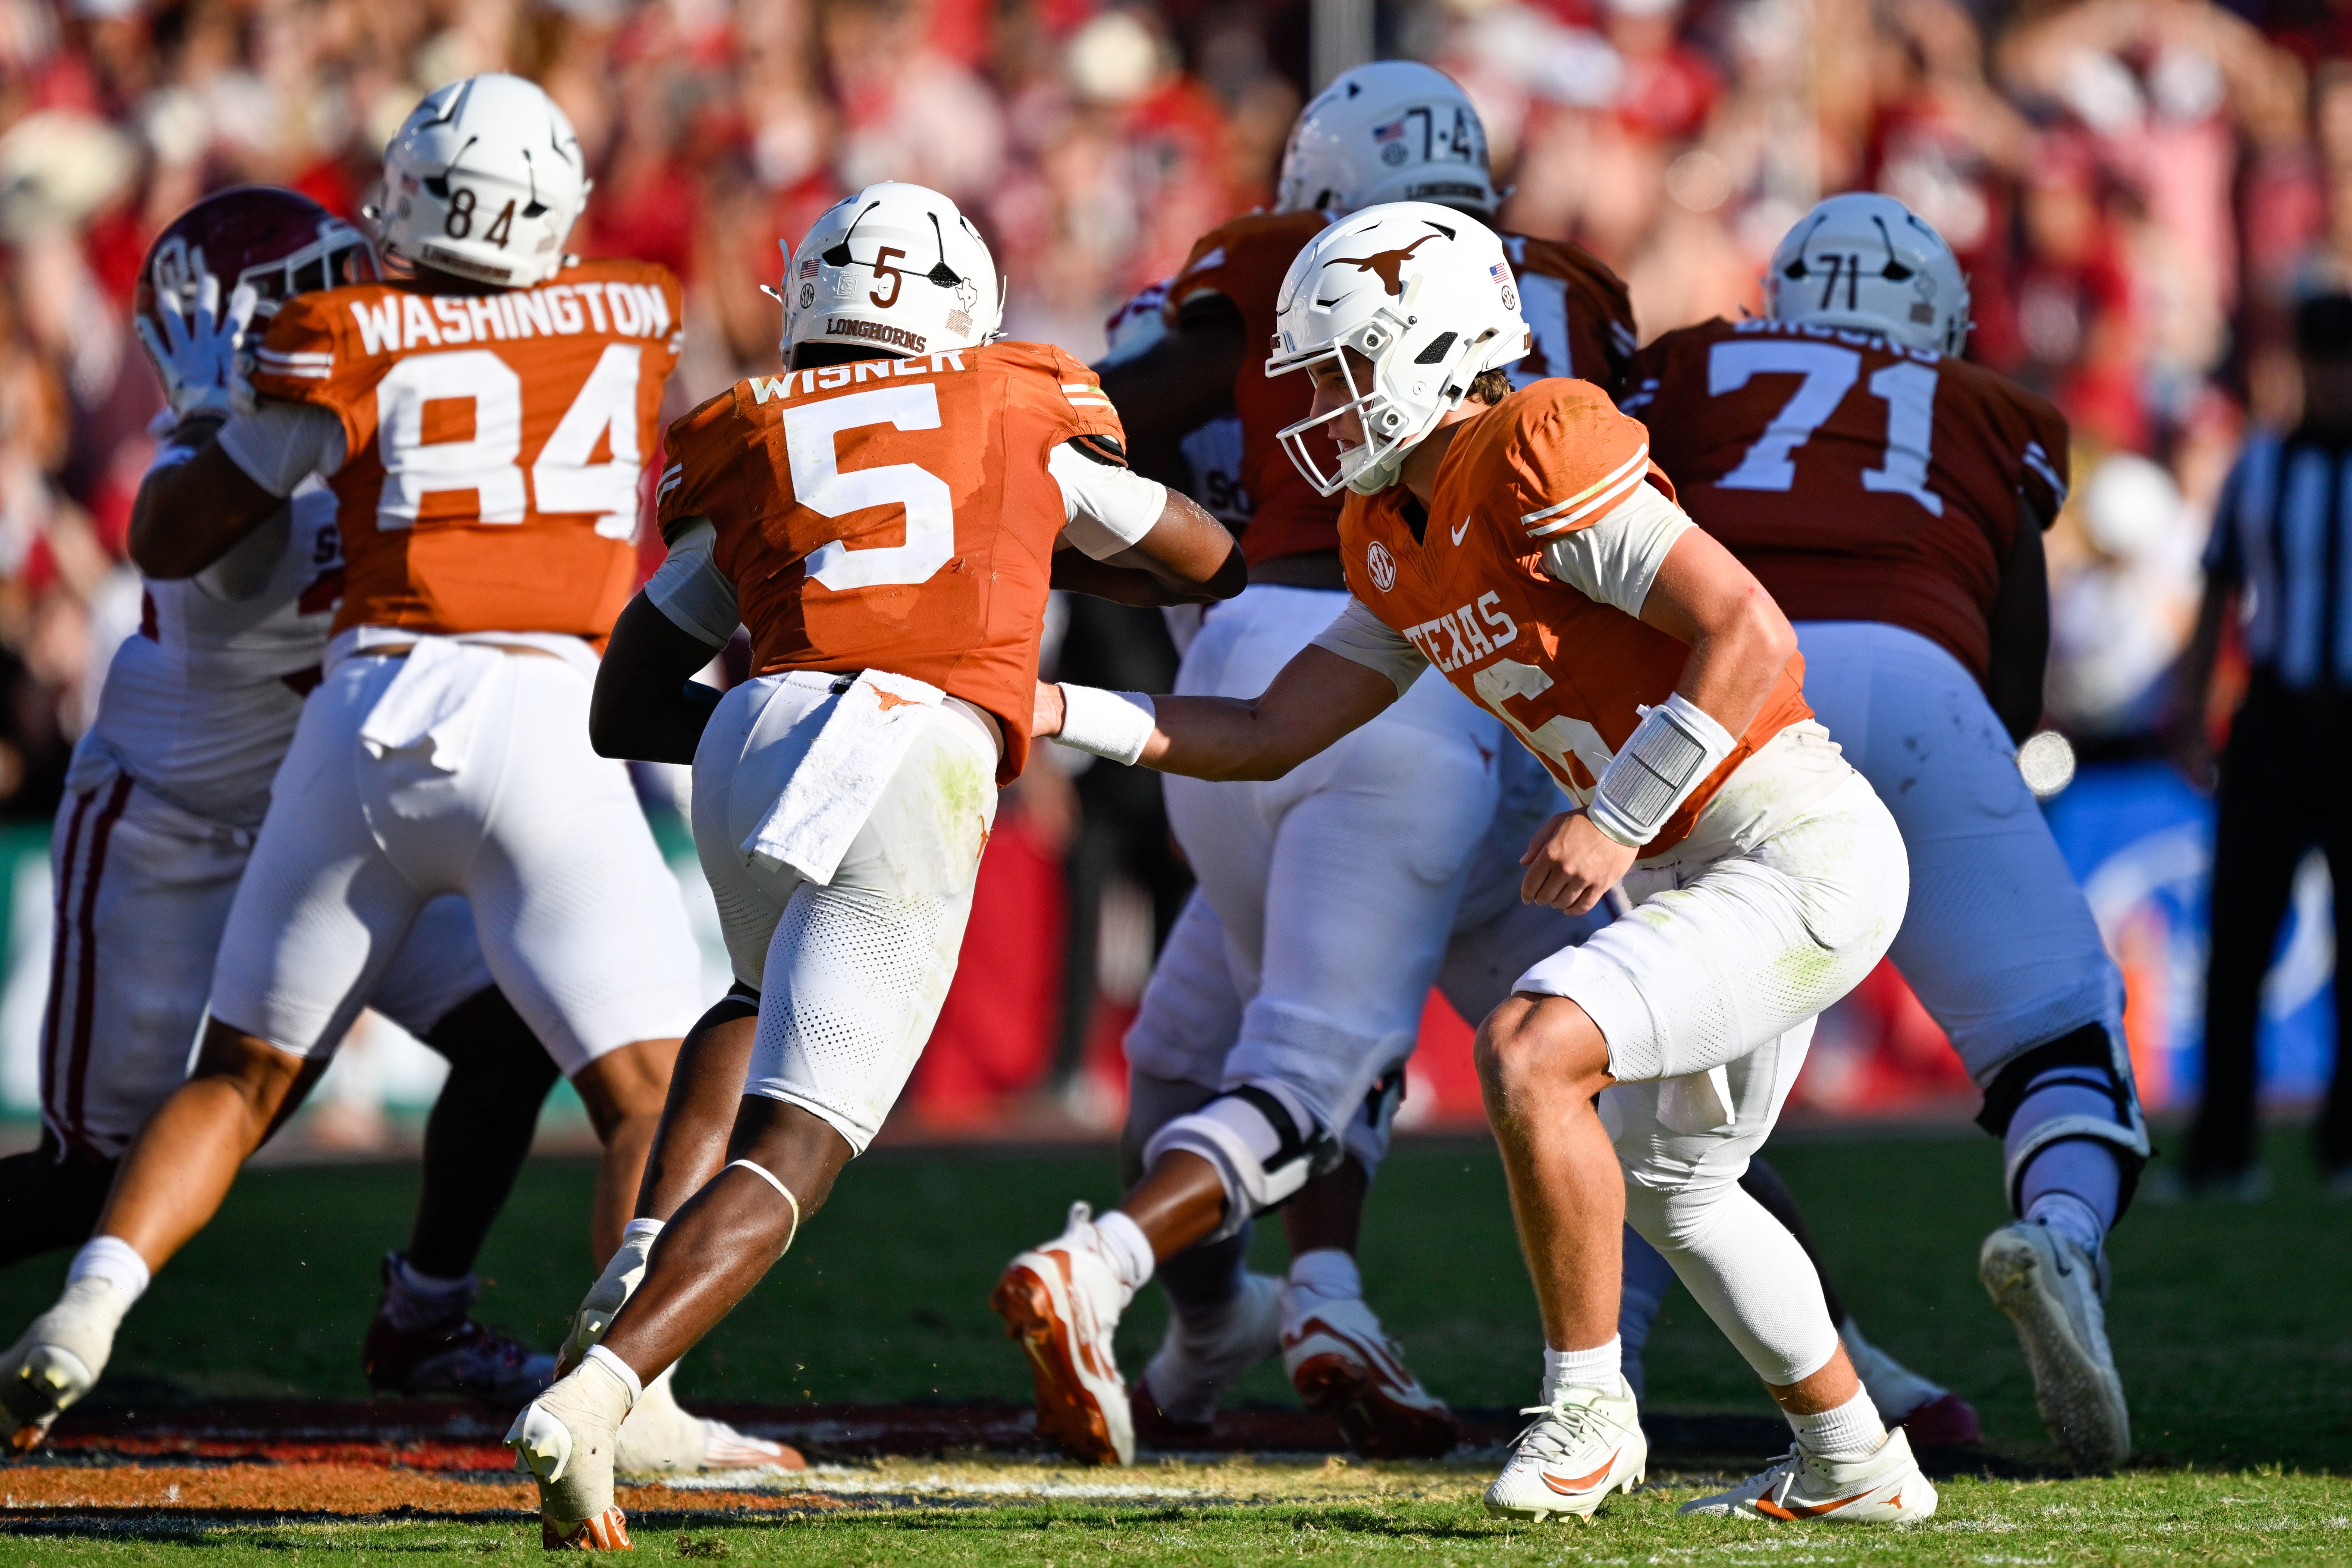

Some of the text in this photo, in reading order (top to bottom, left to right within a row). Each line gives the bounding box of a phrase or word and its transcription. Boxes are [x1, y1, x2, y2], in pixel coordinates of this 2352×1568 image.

[1407, 106, 1472, 163] 74
[446, 188, 515, 250] 84
[870, 246, 906, 309] 5
[1502, 285, 1515, 310] SEC
[1816, 254, 1860, 311] 71
[350, 280, 671, 355] WASHINGTON
[826, 317, 927, 354] LONGHORNS
[747, 348, 967, 405] WISNER
[376, 342, 639, 542] 84
[1708, 339, 1944, 517] 71
[782, 382, 955, 592] 5
[1367, 541, 1396, 592] SEC
[1402, 590, 1518, 672] TEXAS
[1473, 658, 1617, 809] 6
